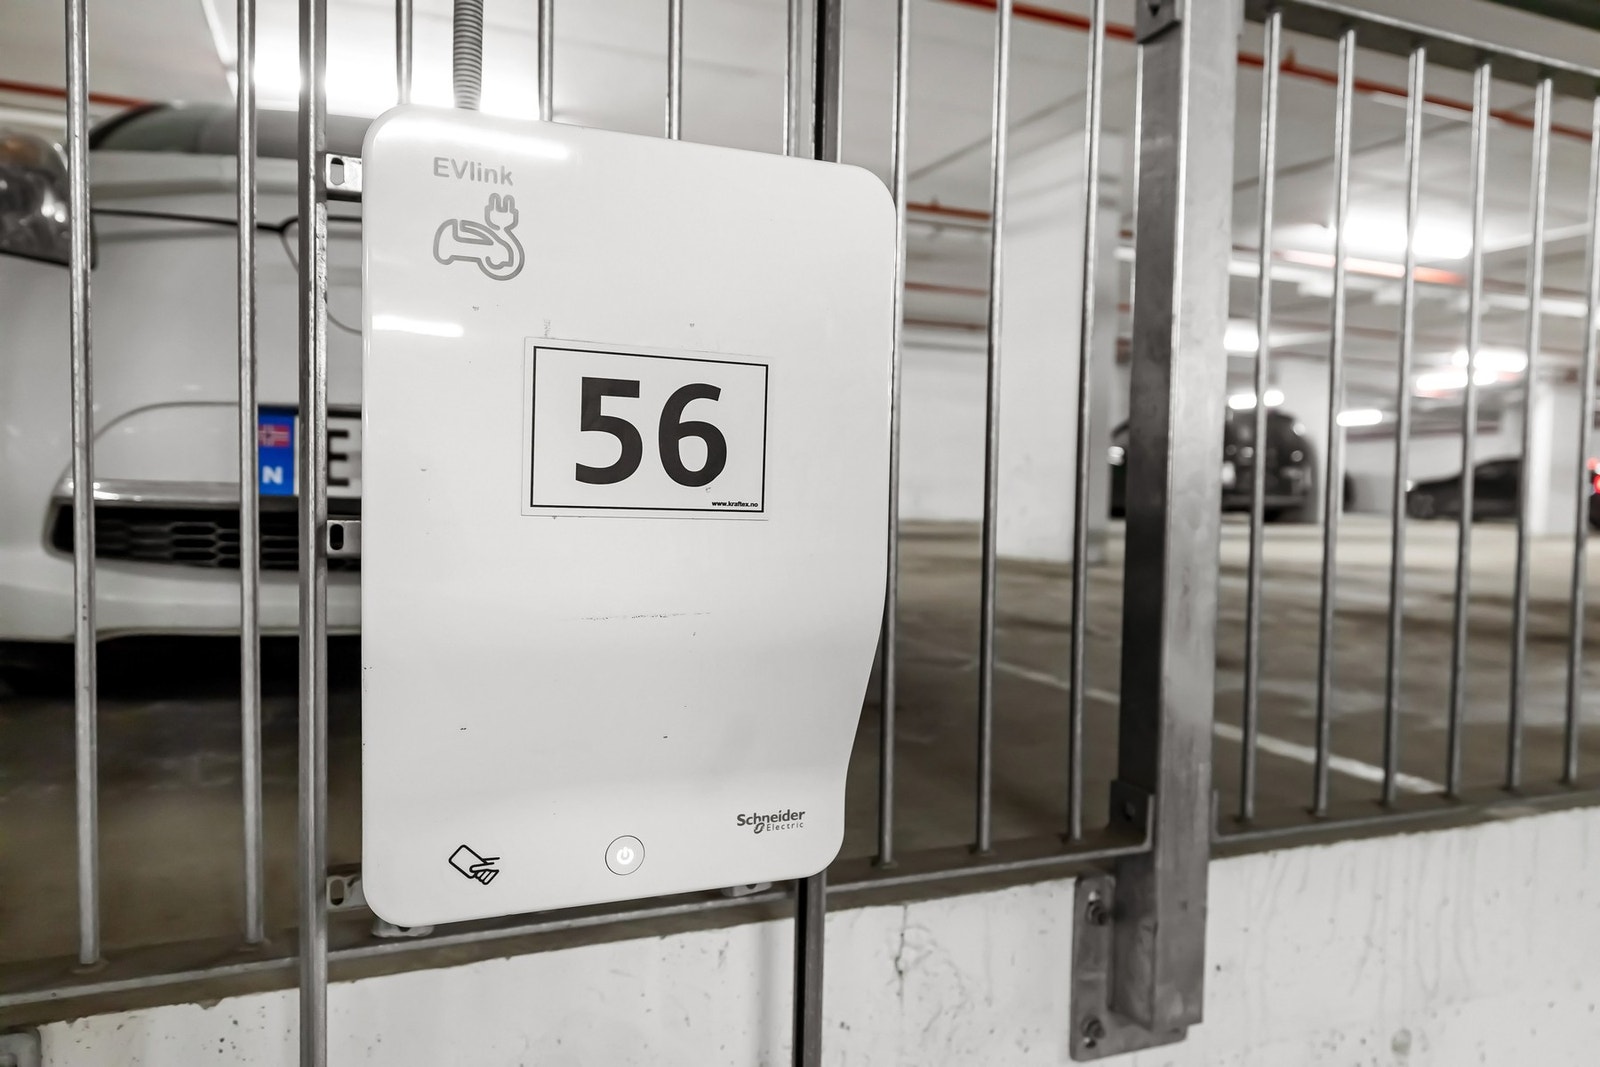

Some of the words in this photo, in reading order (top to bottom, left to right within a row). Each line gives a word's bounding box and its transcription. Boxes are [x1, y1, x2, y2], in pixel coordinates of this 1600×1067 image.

[433, 156, 514, 186] EVlink
[575, 376, 727, 487] 56
[262, 465, 283, 485] N
[711, 500, 759, 508] www.kraftex.no
[736, 808, 806, 827] Schneider
[766, 822, 804, 832] Electric
